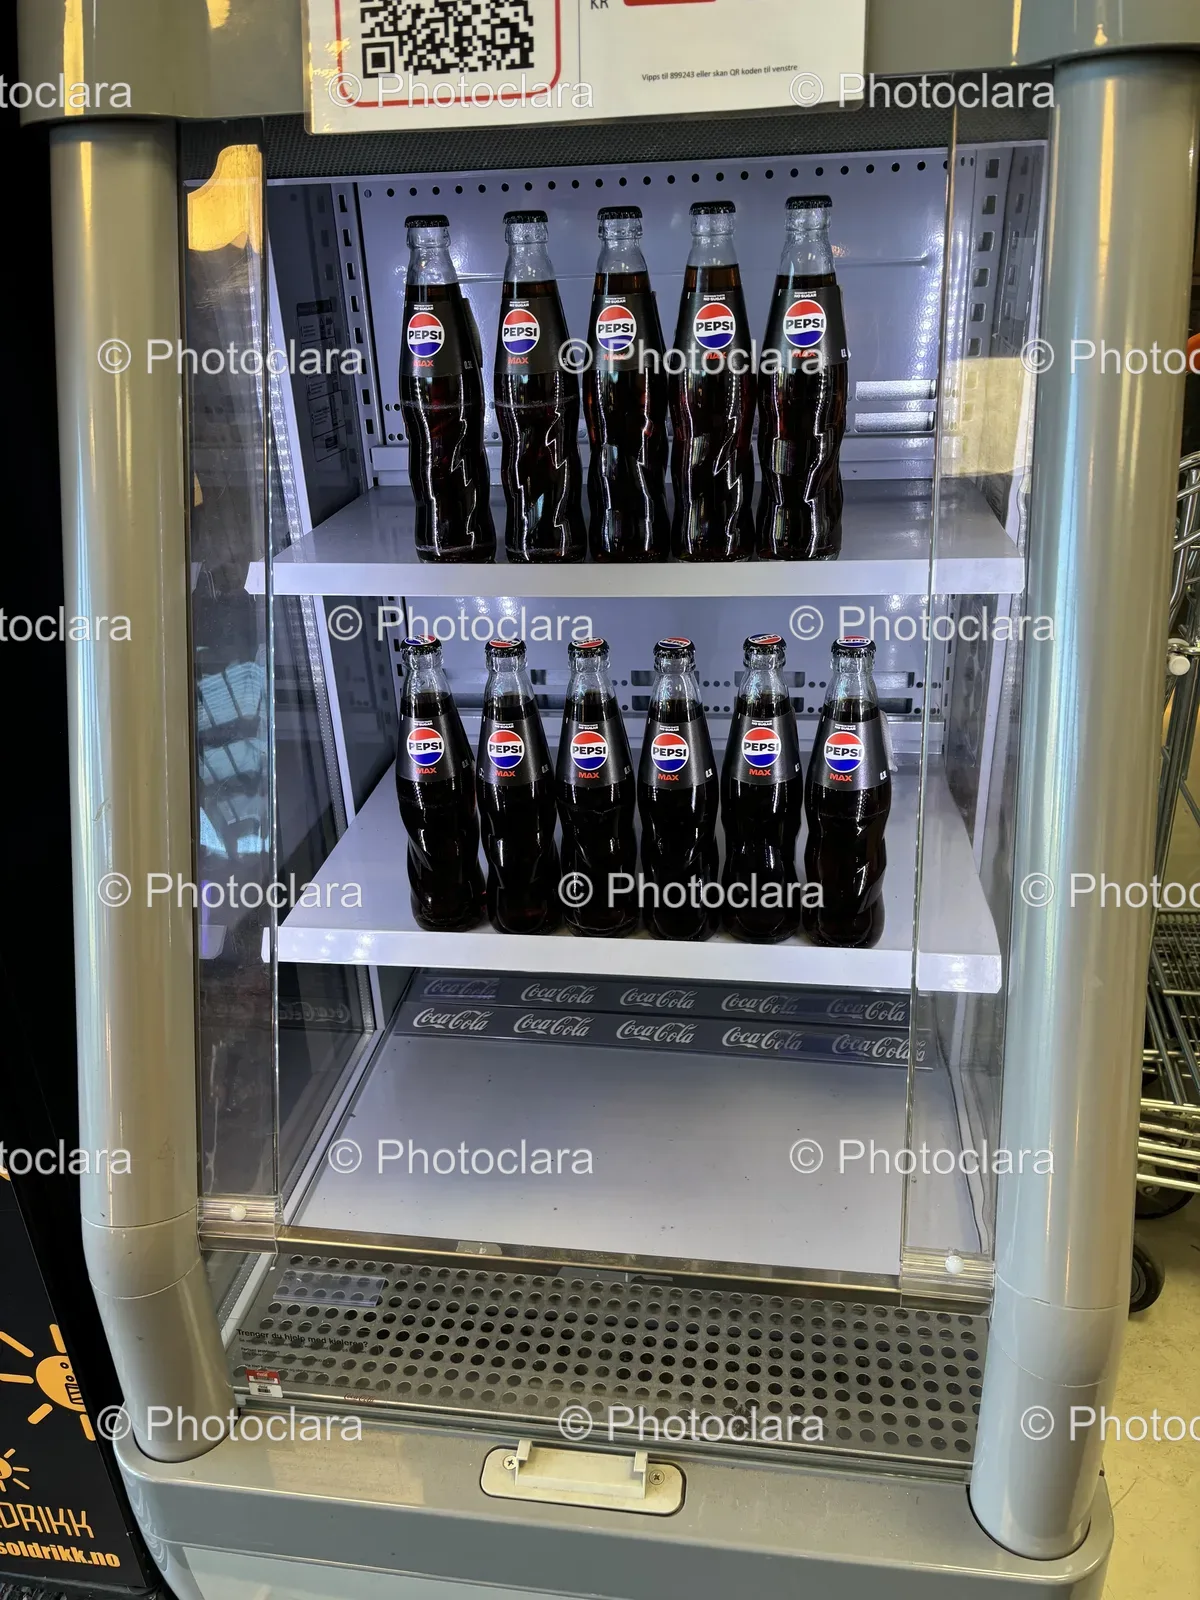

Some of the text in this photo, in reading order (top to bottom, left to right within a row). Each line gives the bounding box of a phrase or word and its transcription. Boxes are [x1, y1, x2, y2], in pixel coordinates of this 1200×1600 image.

[642, 74, 660, 82] Vipps
[669, 71, 695, 79] 899243
[696, 70, 711, 78] eller
[712, 69, 728, 77] skan
[741, 67, 762, 75] koden
[772, 65, 798, 73] venstre
[598, 323, 634, 334] PEPSI
[696, 321, 733, 332] PEPSI
[786, 318, 824, 329] PEPSI
[409, 330, 442, 340] PEPSI
[504, 327, 537, 337] PEPSI
[413, 360, 434, 368] MAX
[508, 357, 529, 365] MAX
[409, 741, 442, 751] PEPSI
[489, 745, 522, 754] PEPSI
[572, 745, 606, 755] PEPSI
[744, 742, 779, 752] PEPSI
[653, 747, 687, 757] PEPSI
[826, 746, 861, 757] PEPSI
[495, 769, 516, 777] MAX
[578, 771, 600, 779] MAX
[657, 773, 679, 781] MAX
[749, 768, 771, 777] MAX
[829, 772, 853, 782] MAX
[521, 983, 598, 1004] Coca-Cola
[619, 988, 698, 1009] Coca-Cola
[721, 992, 800, 1015] Coca-Cola
[826, 998, 908, 1021] Coca-Cola
[413, 1007, 495, 1031] Coca-Cola
[513, 1013, 595, 1037] Coca-Cola
[616, 1019, 698, 1044] Coca-Cola
[722, 1026, 802, 1051] Coca-Cola
[236, 1329, 269, 1339] Trenger
[272, 1332, 282, 1340] du
[284, 1333, 305, 1343] hjelp
[308, 1336, 326, 1344] med
[0, 1501, 95, 1538] DRIKK
